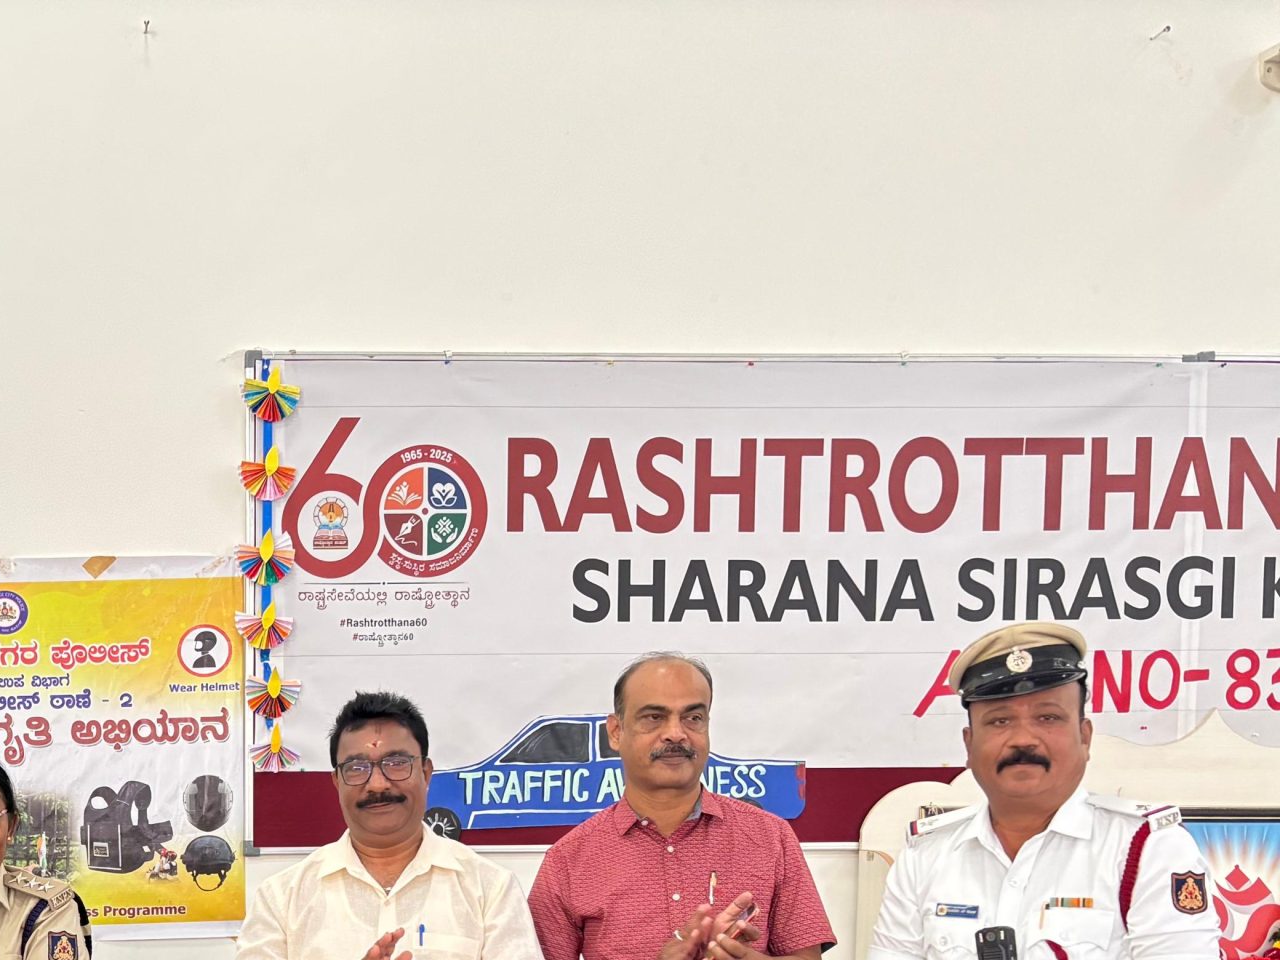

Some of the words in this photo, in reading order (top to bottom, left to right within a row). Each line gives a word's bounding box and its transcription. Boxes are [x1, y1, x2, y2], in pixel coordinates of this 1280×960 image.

[400, 449, 422, 463] 1965
[430, 448, 453, 463] 2025
[298, 588, 388, 610] ರಾಷ್ಟ್ರಸೇವೆಯಲ್ಲಿ
[394, 587, 470, 609] ರಾಷ್ಟ್ರೋತ್ಥಾನ
[572, 558, 935, 623] SHARANA
[957, 556, 1235, 622] SIRASGI
[340, 617, 428, 628] #Rashtrotthana60
[51, 639, 150, 670] ಪೊಲೀಸ್
[31, 673, 70, 689] ವಿಭಾಗ
[169, 684, 197, 692] Wear
[201, 682, 240, 692] Helmet
[50, 689, 91, 709] ಠಾಣೆ
[120, 693, 133, 707] 2
[71, 707, 230, 751] ಅಭಿಯಾನ
[459, 767, 590, 806] TRAFFIC
[596, 765, 767, 804] ANESS
[103, 904, 187, 918] Programme
